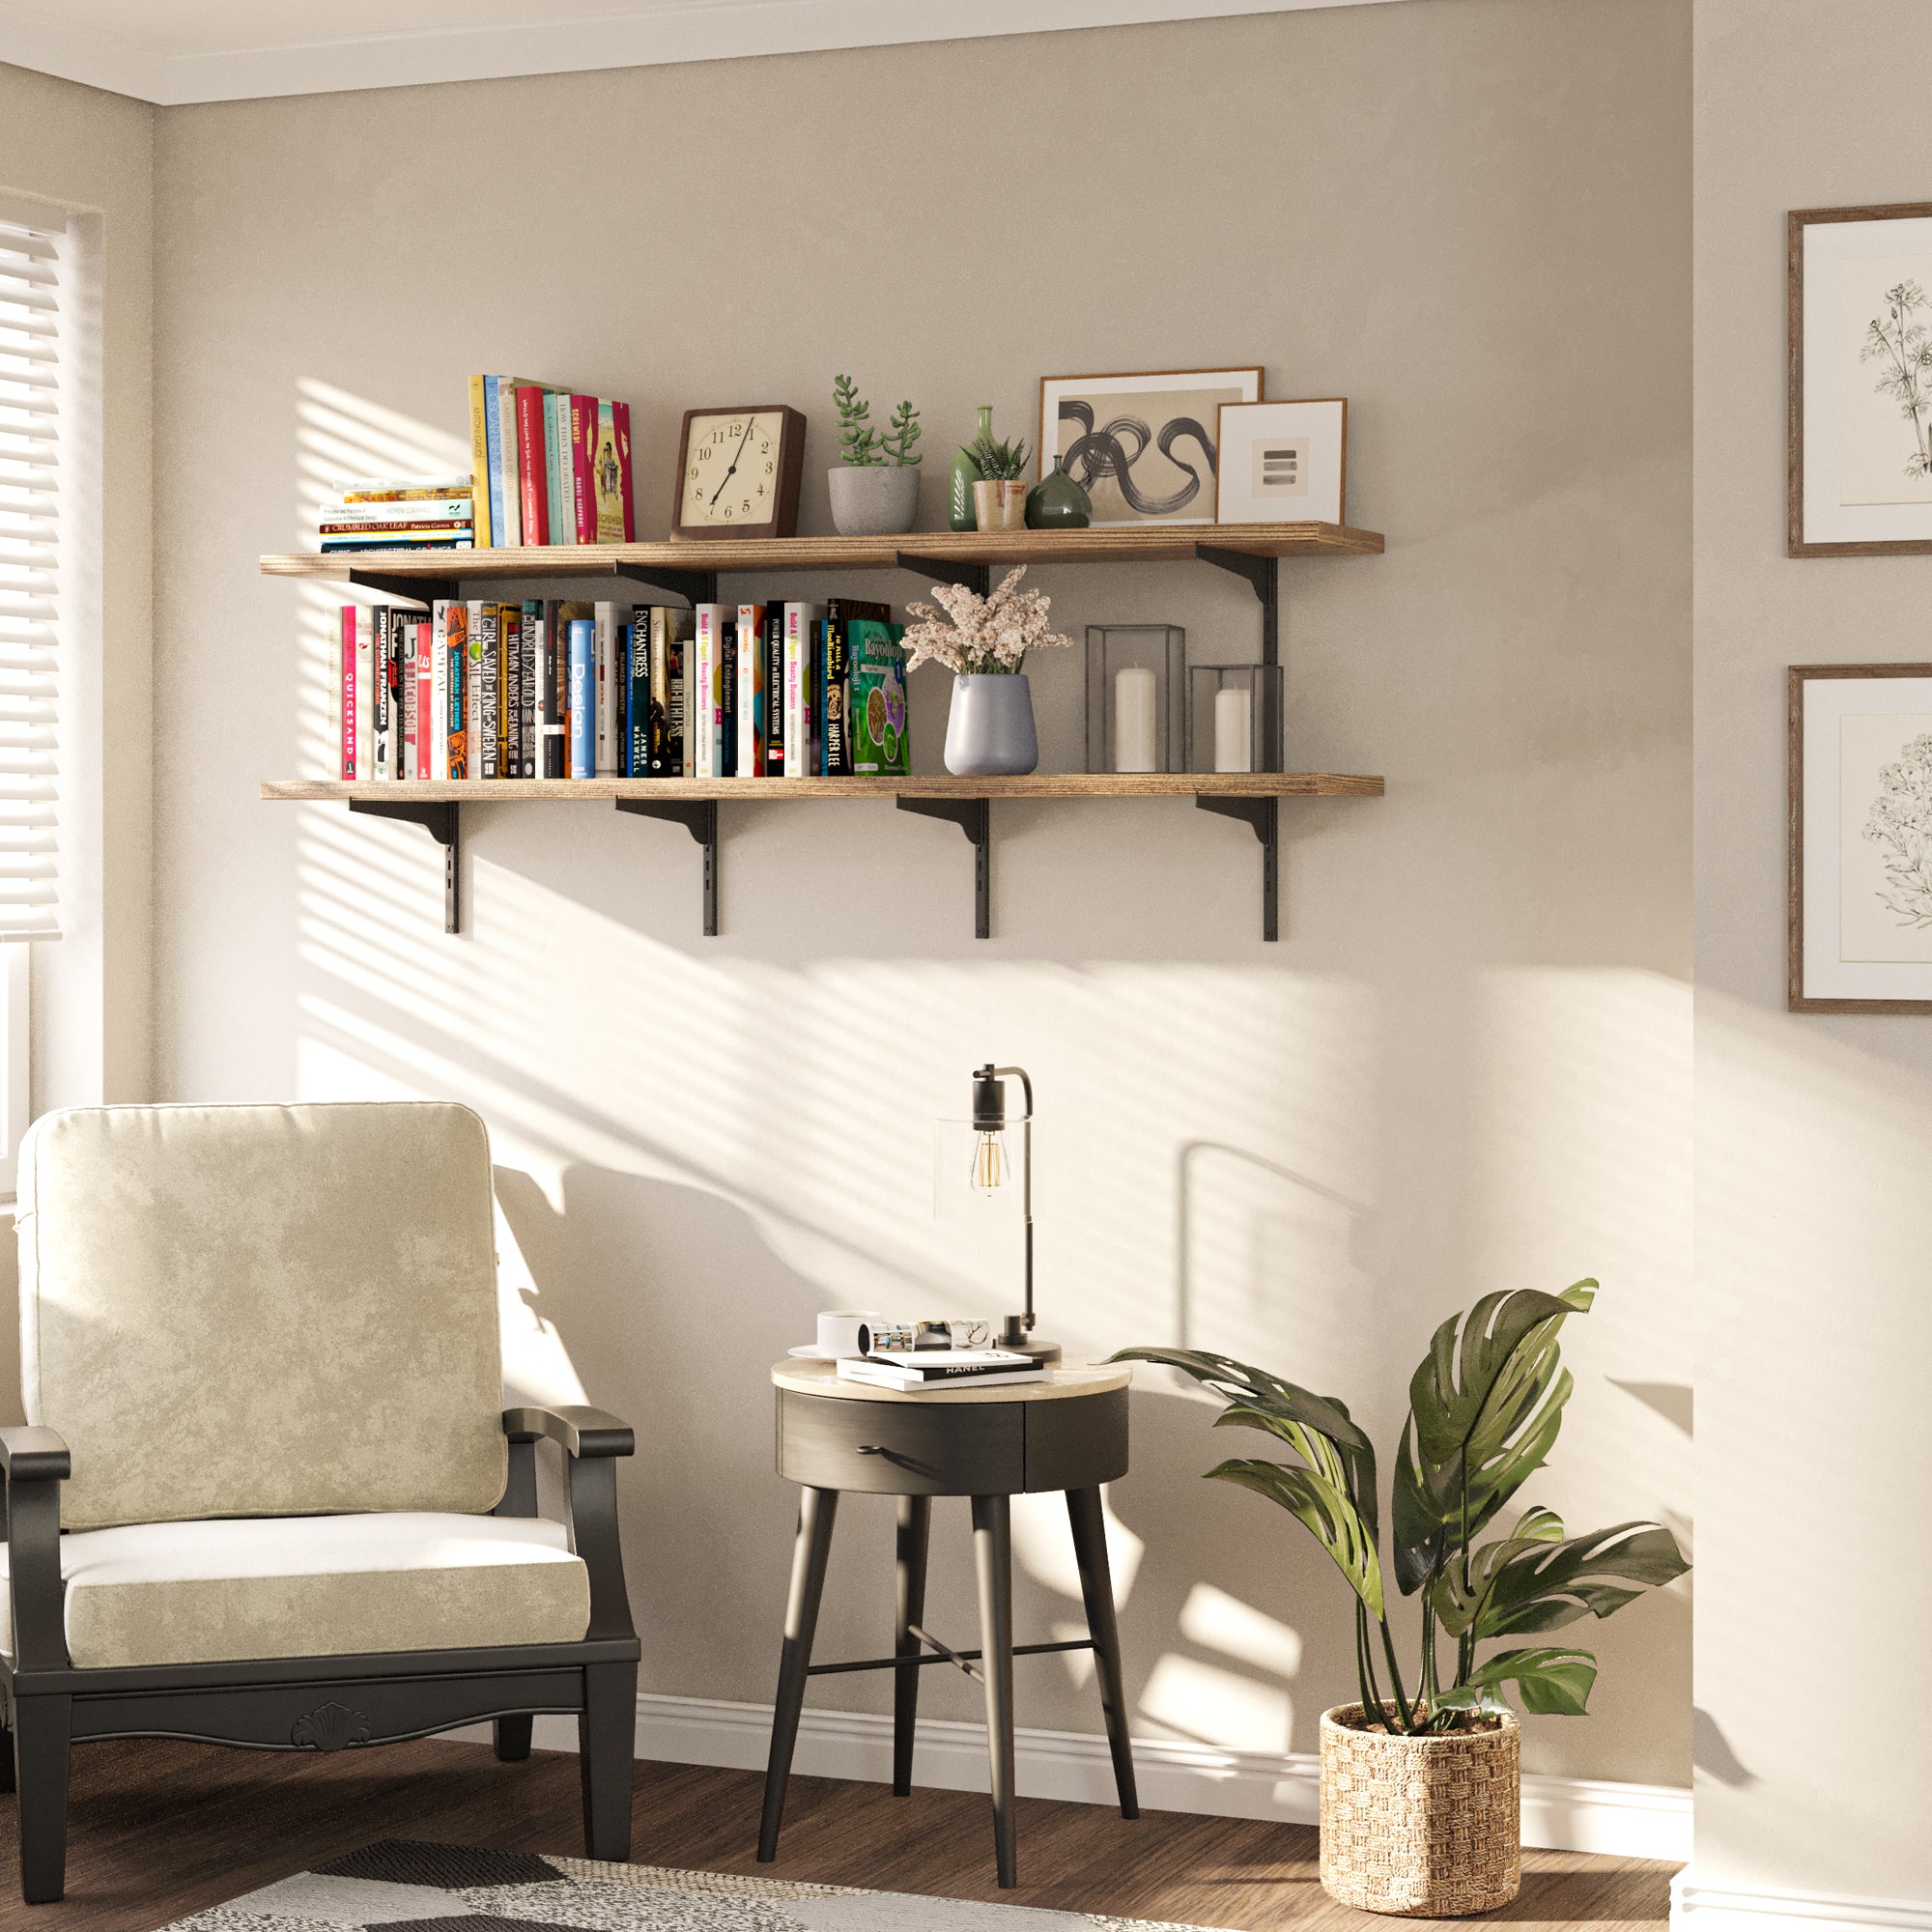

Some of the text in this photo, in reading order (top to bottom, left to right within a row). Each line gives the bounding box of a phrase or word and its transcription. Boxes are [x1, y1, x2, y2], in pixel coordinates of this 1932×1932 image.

[572, 409, 581, 444] SCREWED!
[712, 431, 724, 444] 11
[728, 424, 742, 438] 12
[749, 428, 754, 440] 1
[697, 446, 711, 461] 10
[760, 441, 769, 454] 2
[487, 393, 504, 537] OSCAR NIEMEYER HOUSES
[561, 450, 571, 503] DECORATED
[691, 468, 698, 480] 9
[764, 462, 773, 474] 3
[695, 488, 703, 500] 8
[756, 482, 764, 496] 4
[724, 505, 732, 519] 6
[742, 499, 751, 512] 5
[332, 524, 372, 532] CRUMBLED
[482, 618, 497, 642] GIRL
[508, 634, 520, 671] HITMAN
[635, 611, 648, 678] ENCHANTRESS
[724, 636, 733, 661] Digital
[827, 624, 836, 680] Mockingbird
[482, 650, 497, 684] SAVED
[788, 661, 797, 683] Beauty
[851, 644, 861, 686] Bayooloji
[508, 672, 520, 708] ANDERS
[572, 663, 585, 738] Design
[724, 664, 733, 713] Entanglement
[471, 685, 481, 722] Effect
[482, 692, 497, 716] KING
[482, 721, 497, 760] SWEDEN
[508, 709, 519, 750] MEANING
[828, 724, 840, 767] HARPER LEE
